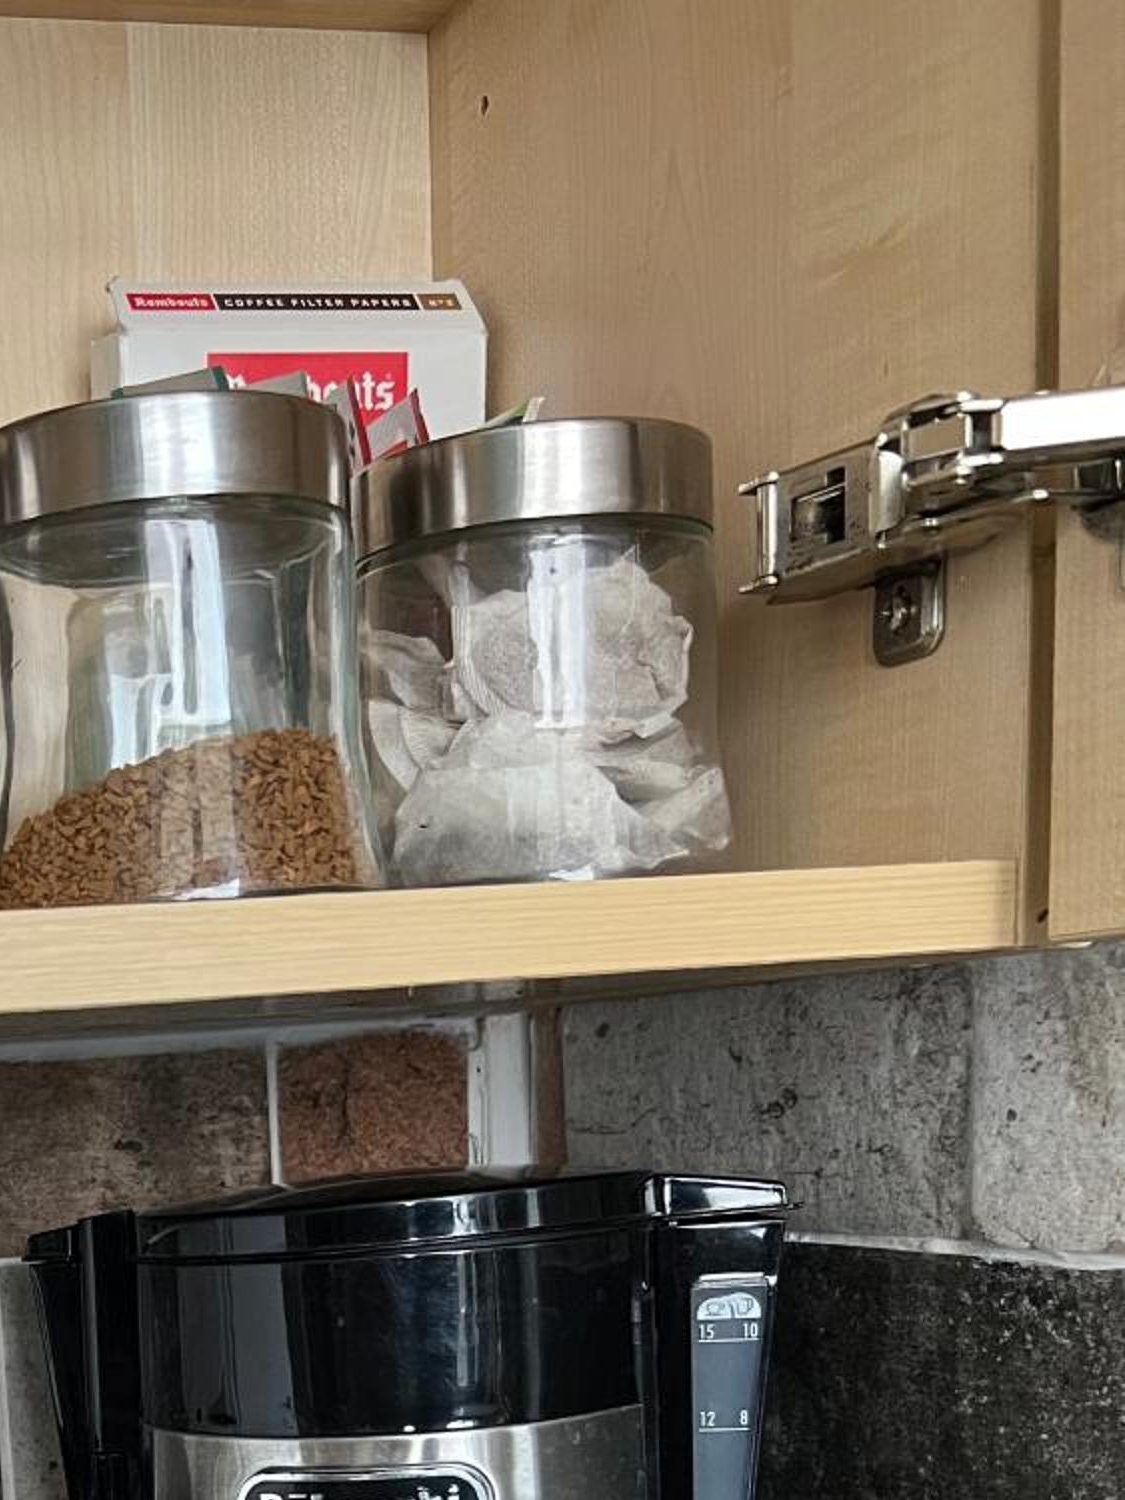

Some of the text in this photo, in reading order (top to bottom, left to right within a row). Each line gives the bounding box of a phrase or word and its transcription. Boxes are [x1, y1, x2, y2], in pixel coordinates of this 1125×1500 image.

[224, 298, 285, 308] COFFEE
[290, 297, 345, 308] FILTER
[350, 297, 412, 308] PAPERS
[699, 1322, 759, 1340] 15 10
[699, 1409, 749, 1427] 12 8
